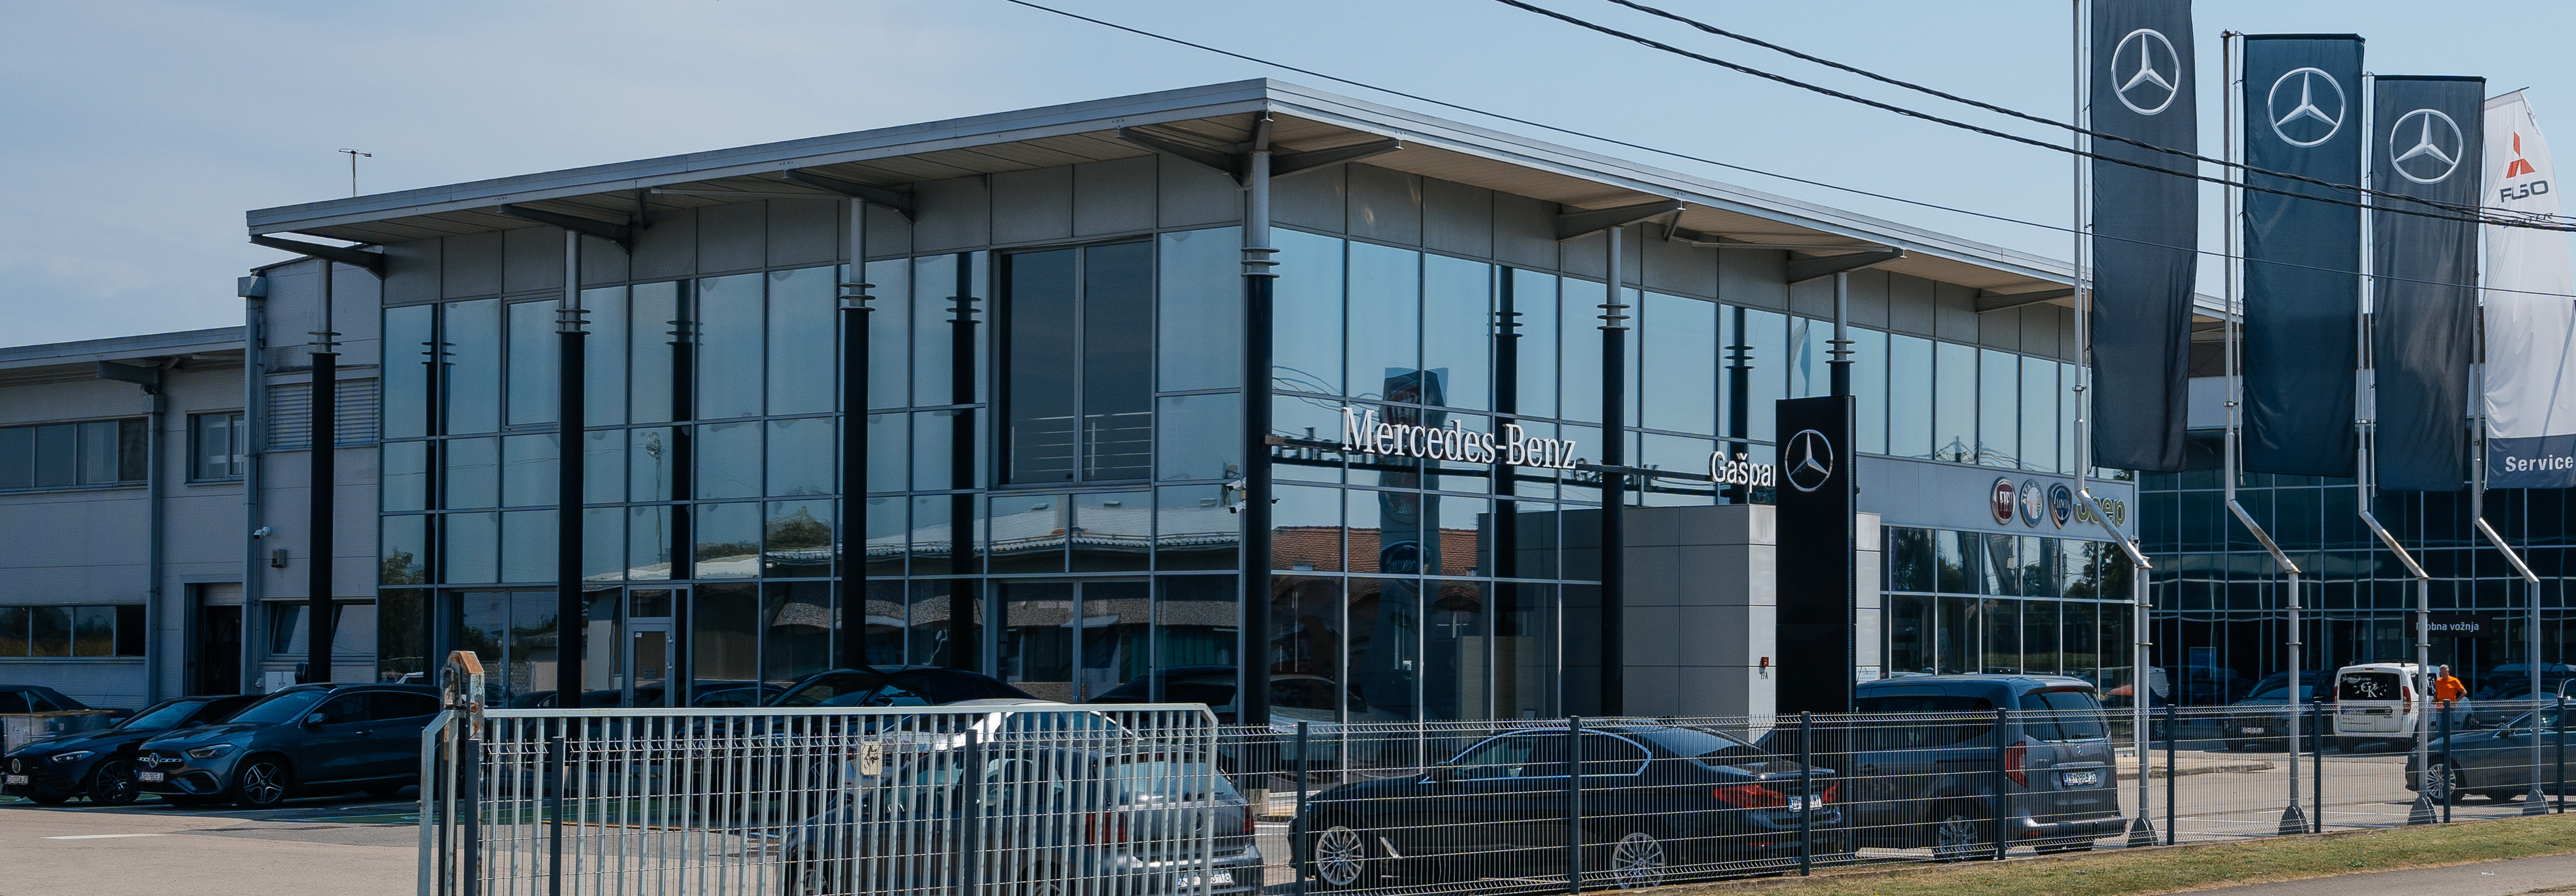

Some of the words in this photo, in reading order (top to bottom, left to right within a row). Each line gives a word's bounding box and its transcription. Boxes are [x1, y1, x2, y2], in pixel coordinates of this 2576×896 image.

[1342, 407, 1577, 469] Mercedes-Benz
[2505, 454, 2574, 472] Service
[2000, 490, 2013, 512] FIAT
[2416, 621, 2447, 631] obna
[2450, 621, 2479, 632] vožnja
